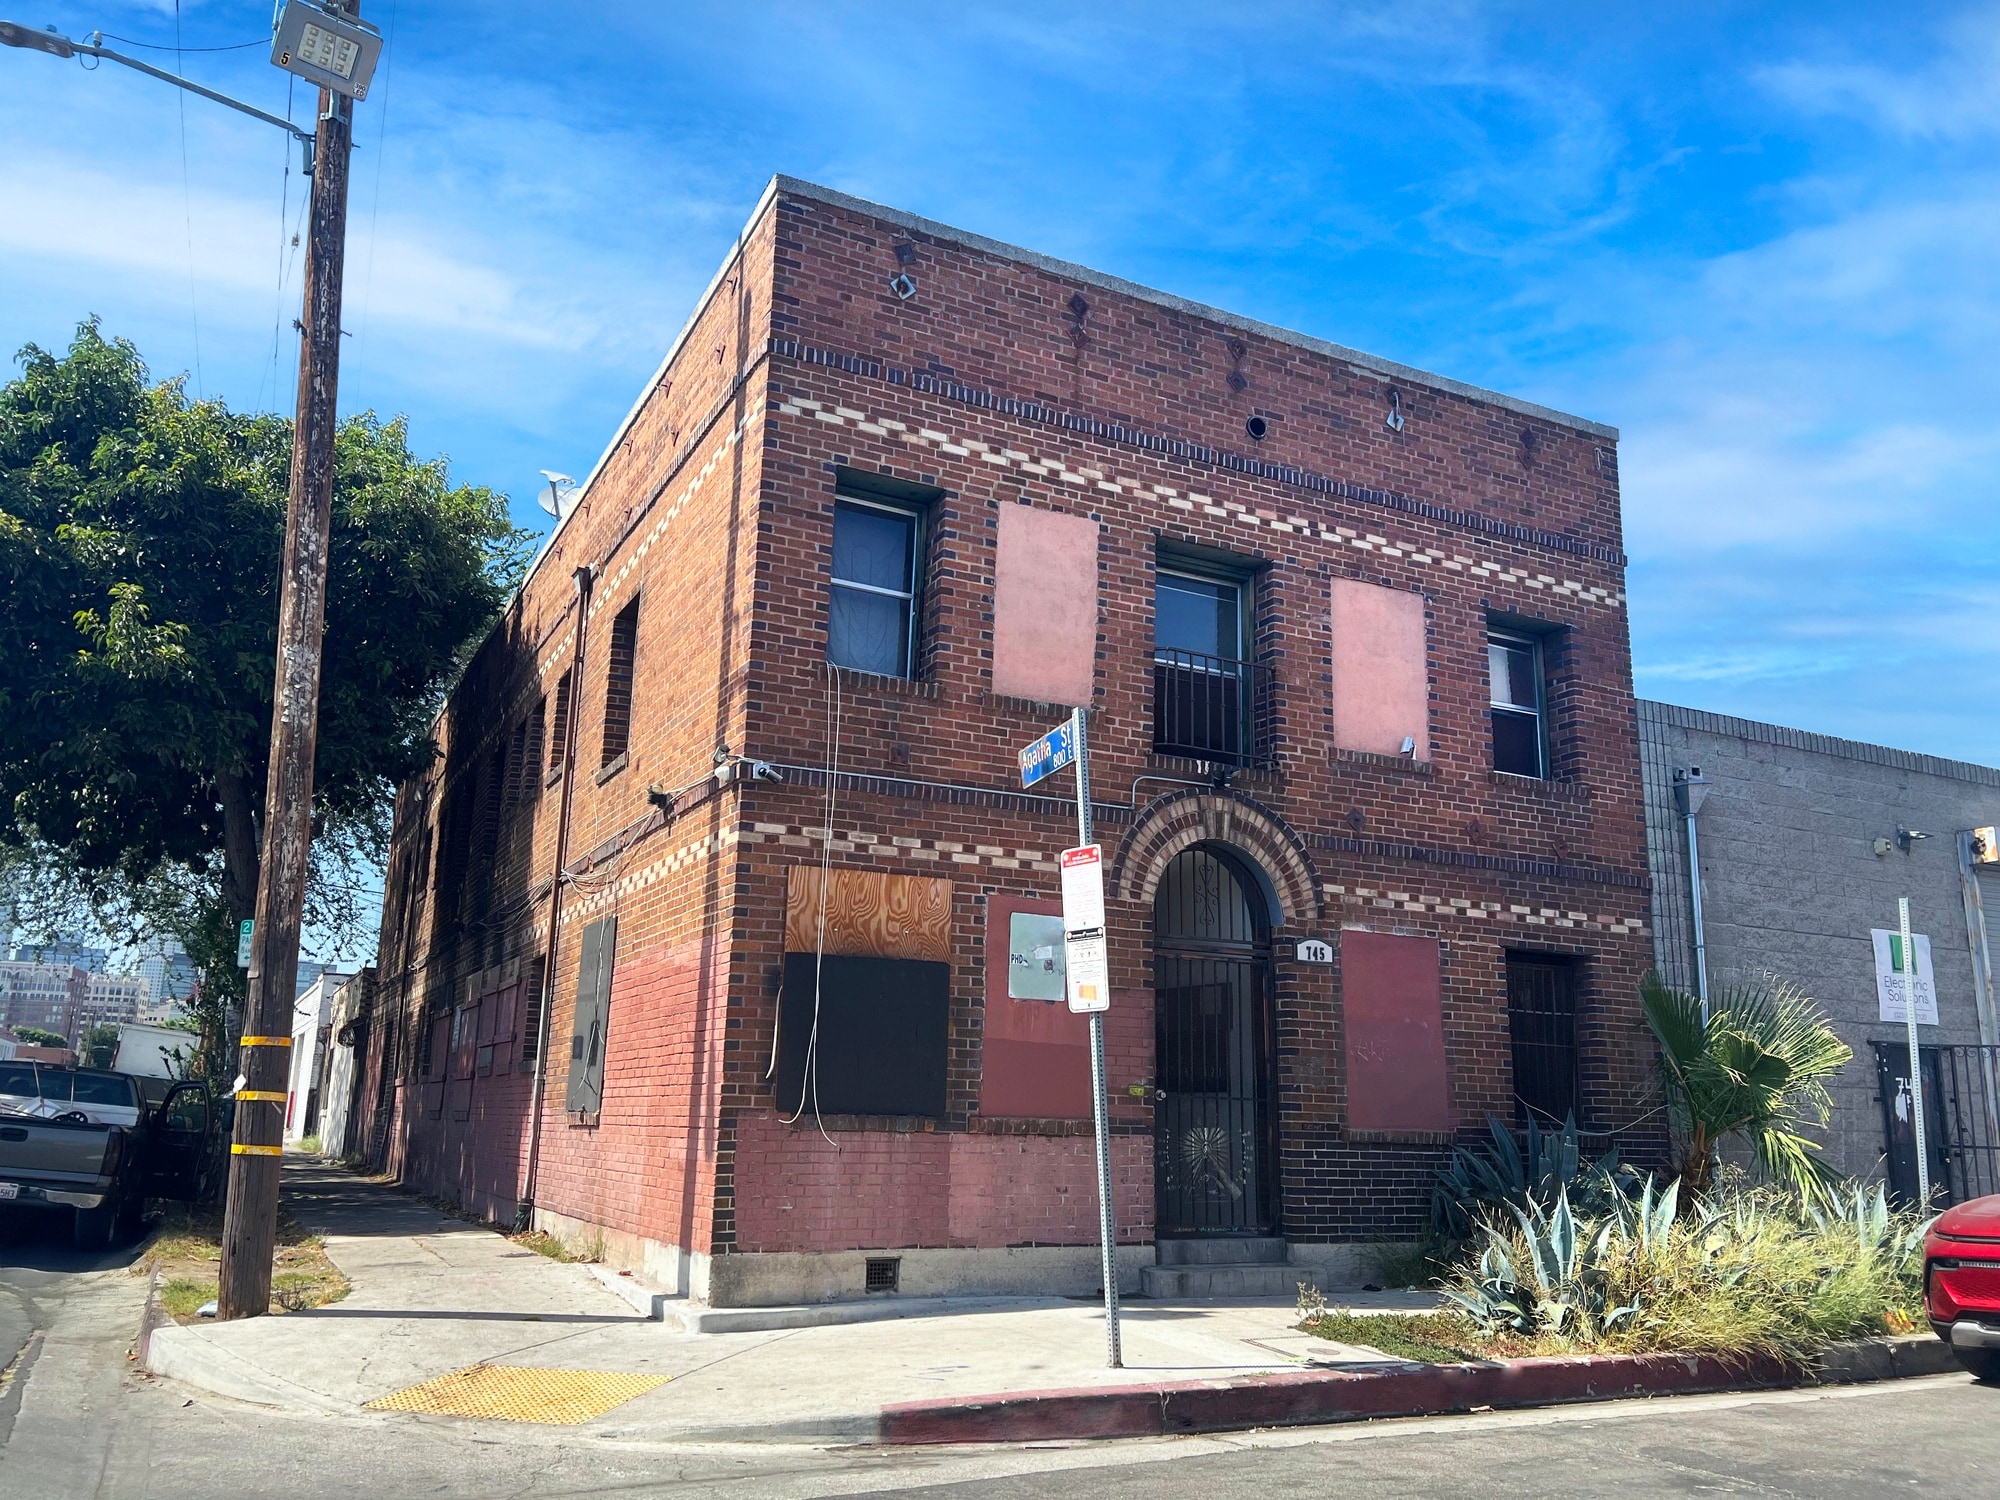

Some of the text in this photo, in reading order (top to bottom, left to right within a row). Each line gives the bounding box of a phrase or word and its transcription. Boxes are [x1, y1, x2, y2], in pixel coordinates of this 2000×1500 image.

[281, 52, 290, 65] 5
[353, 88, 364, 97] LED
[1022, 725, 1071, 774] Agatha St
[1053, 744, 1073, 769] 800 E
[243, 922, 250, 933] 2
[1306, 945, 1325, 961] 745
